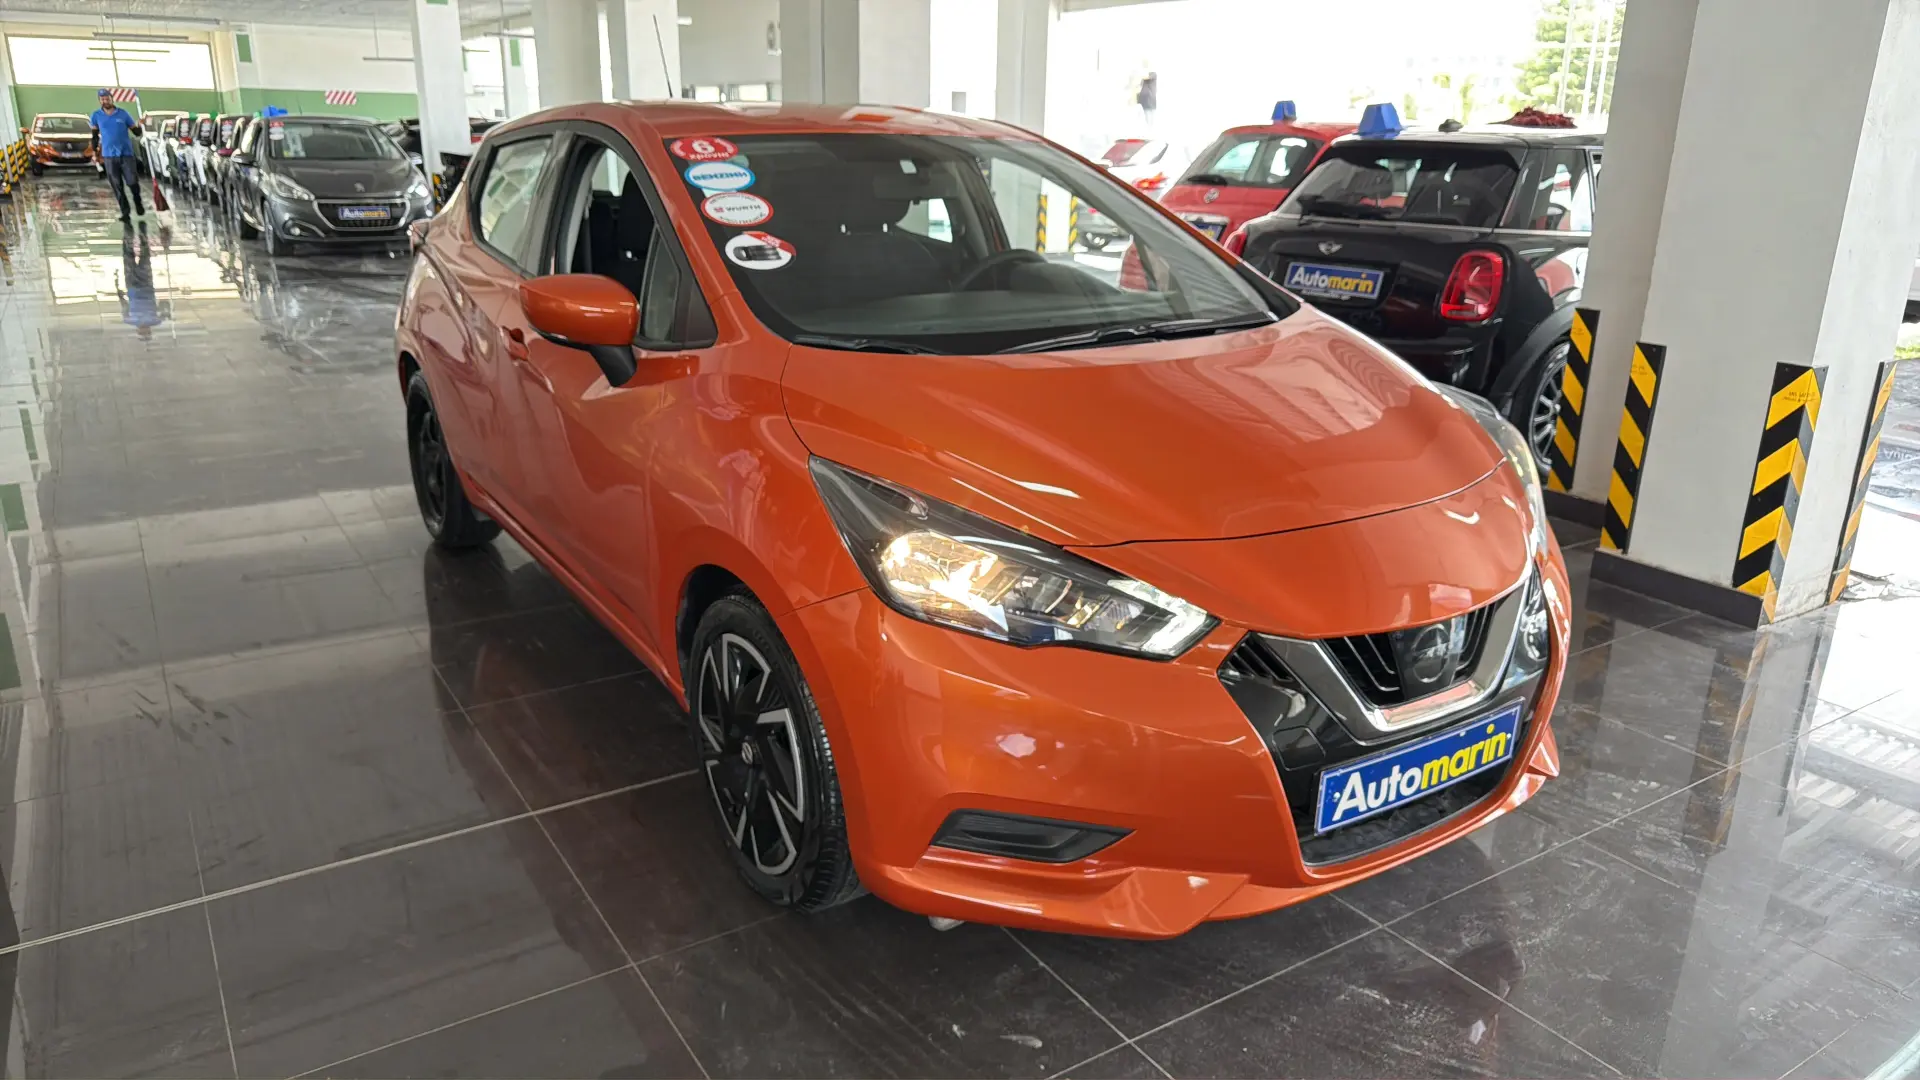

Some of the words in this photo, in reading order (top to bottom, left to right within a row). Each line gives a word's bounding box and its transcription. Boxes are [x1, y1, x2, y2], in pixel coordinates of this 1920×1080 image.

[692, 140, 714, 153] 6
[1291, 266, 1374, 293] Automarin
[1332, 723, 1507, 822] Automarin
